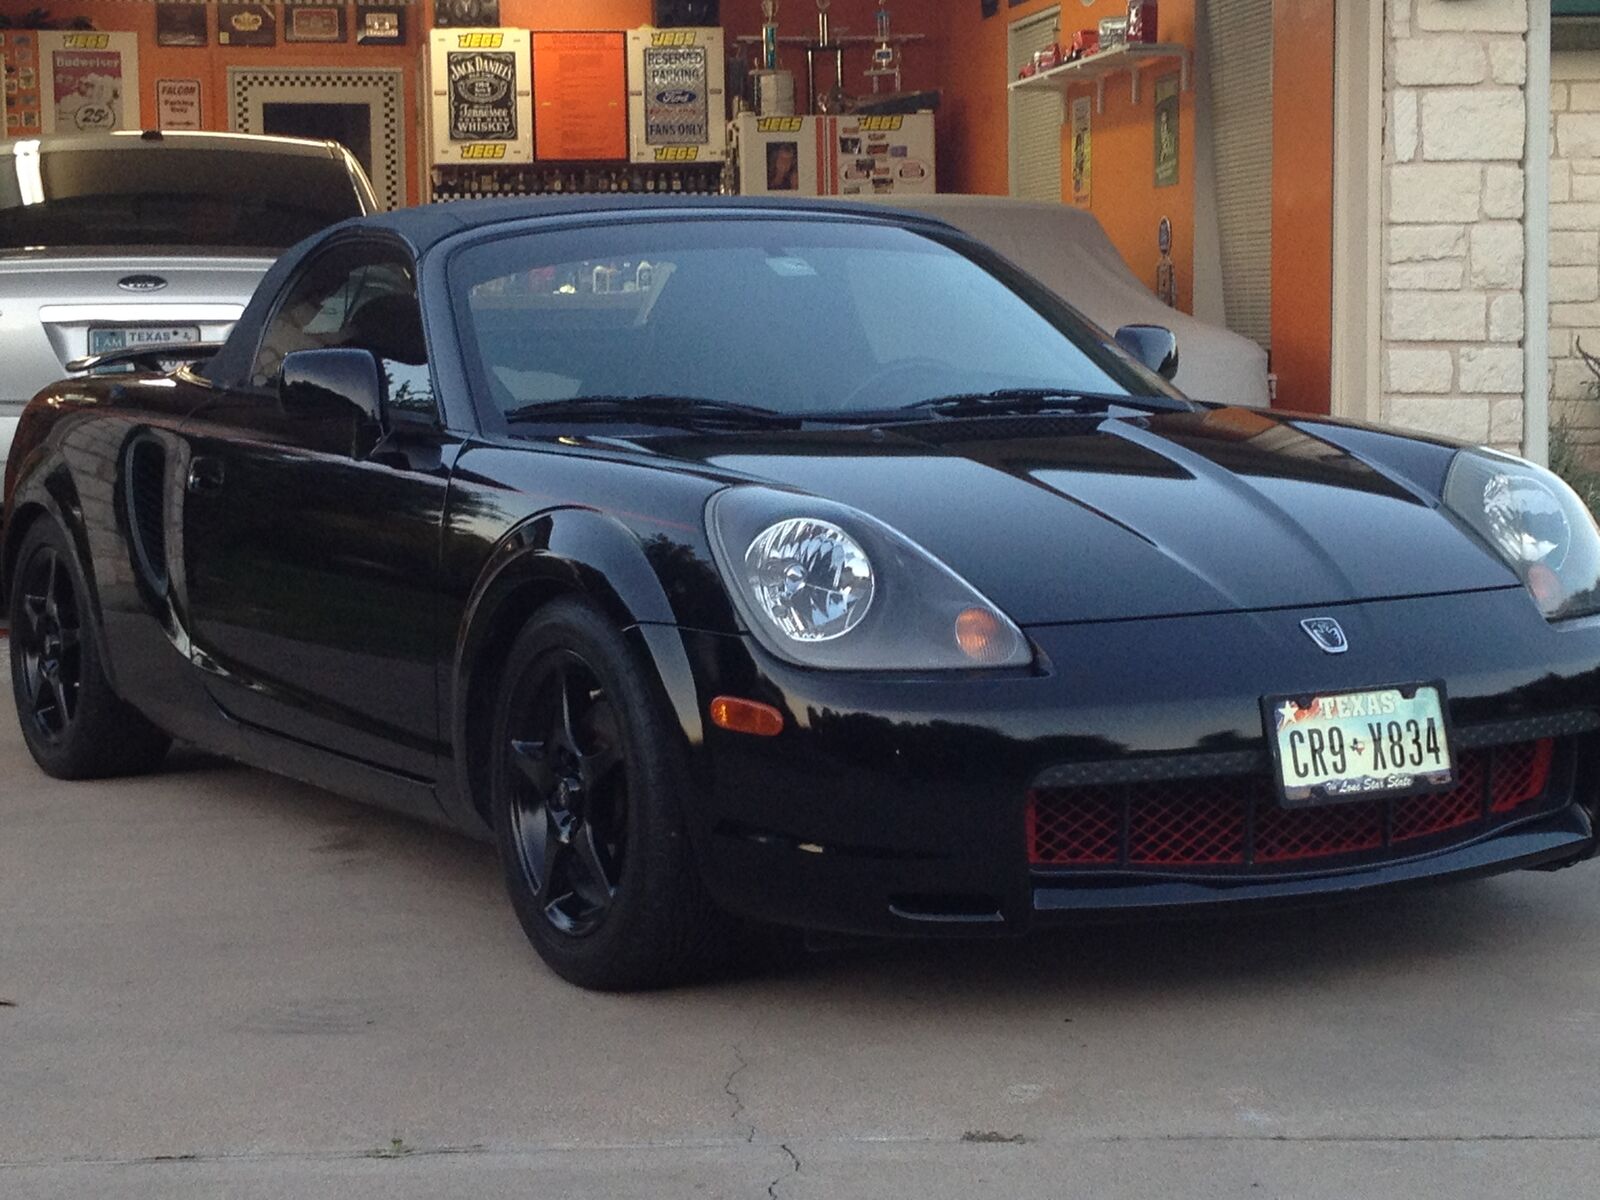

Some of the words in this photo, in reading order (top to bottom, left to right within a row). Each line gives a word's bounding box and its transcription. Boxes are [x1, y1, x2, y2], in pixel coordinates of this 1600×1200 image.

[458, 33, 504, 48] JEGS
[651, 31, 697, 47] JEGS
[648, 51, 703, 65] RESERVED
[451, 60, 475, 81] JACK
[652, 68, 699, 81] PARKING
[457, 122, 510, 132] WHISKEY
[649, 124, 676, 136] FANS
[678, 123, 704, 136] ONLY
[757, 116, 803, 132] JEGS
[858, 115, 904, 131] JEGS
[461, 144, 507, 159] JEGS
[654, 146, 699, 161] JEGS
[128, 331, 171, 342] TEXAS
[1319, 691, 1397, 720] TEXAS
[1289, 726, 1346, 778] CR9
[1368, 717, 1440, 771] X834
[1339, 779, 1361, 793] Lone
[1364, 778, 1384, 791] Star
[1387, 775, 1412, 788] State
